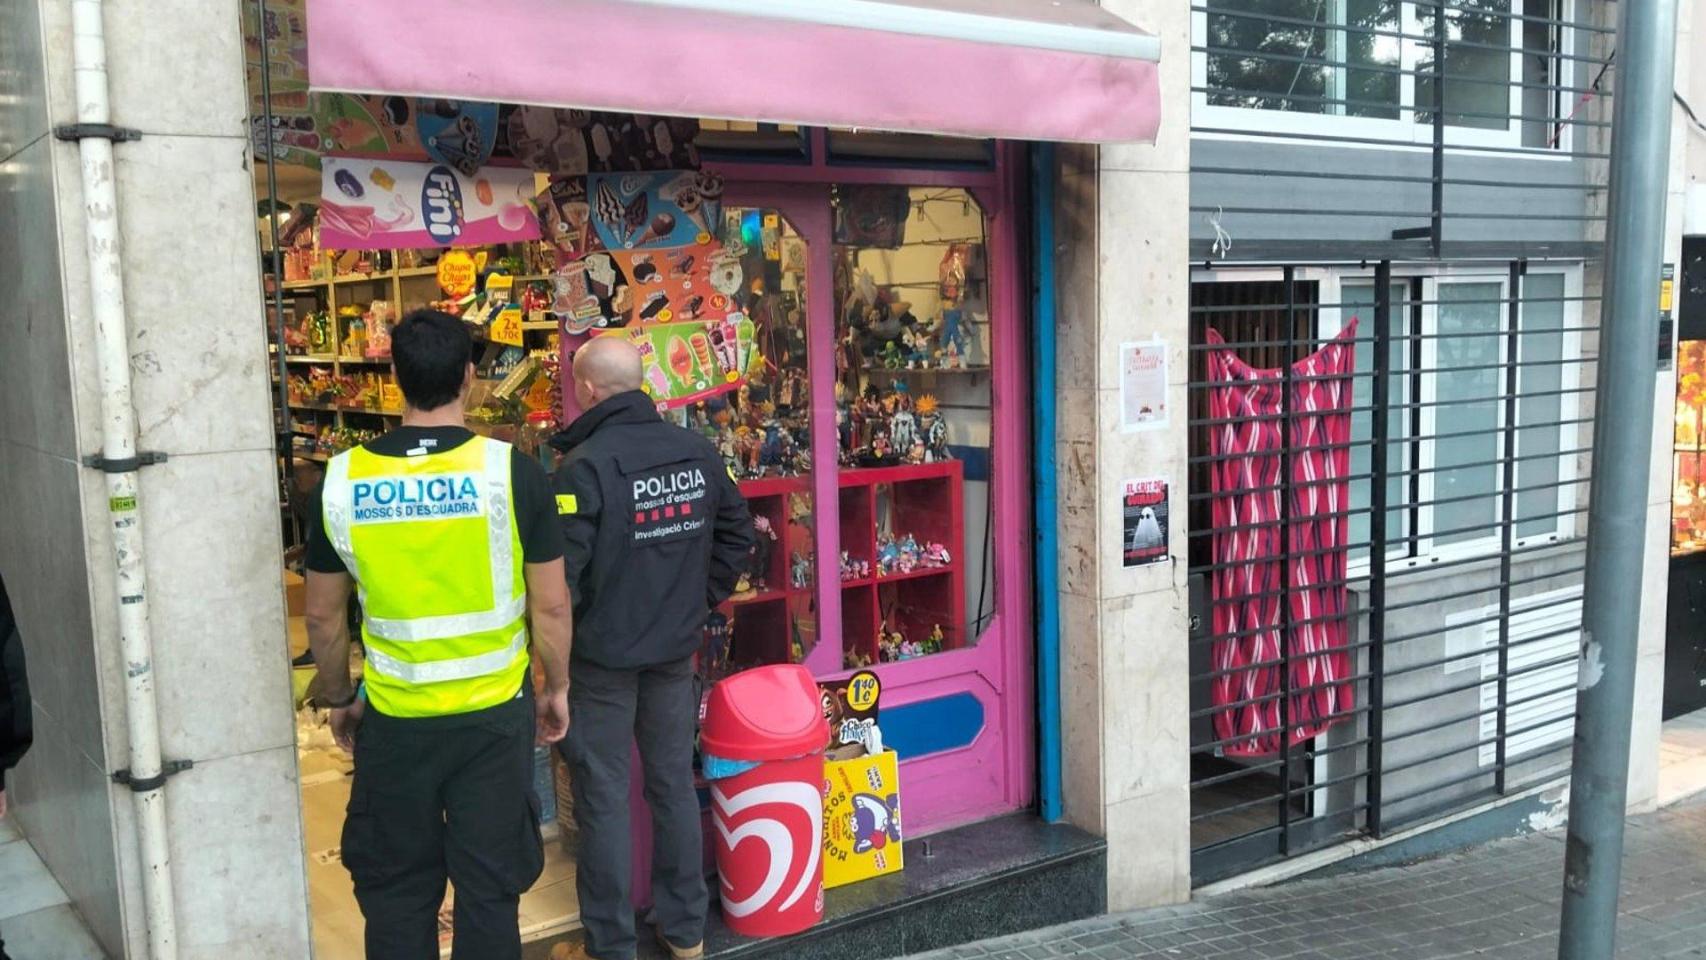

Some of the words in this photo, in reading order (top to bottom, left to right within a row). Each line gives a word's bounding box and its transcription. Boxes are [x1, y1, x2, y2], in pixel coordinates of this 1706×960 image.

[426, 172, 461, 237] Fini
[503, 318, 519, 330] 2x
[354, 477, 479, 507] POLICIA
[632, 468, 706, 500] POLICIA
[1126, 483, 1135, 493] EL
[635, 497, 665, 511] mossos
[666, 488, 706, 504] d'esquadr
[355, 505, 403, 521] MOSSOS
[405, 502, 478, 517] D'ESQUADRA
[634, 523, 682, 540] Investigació
